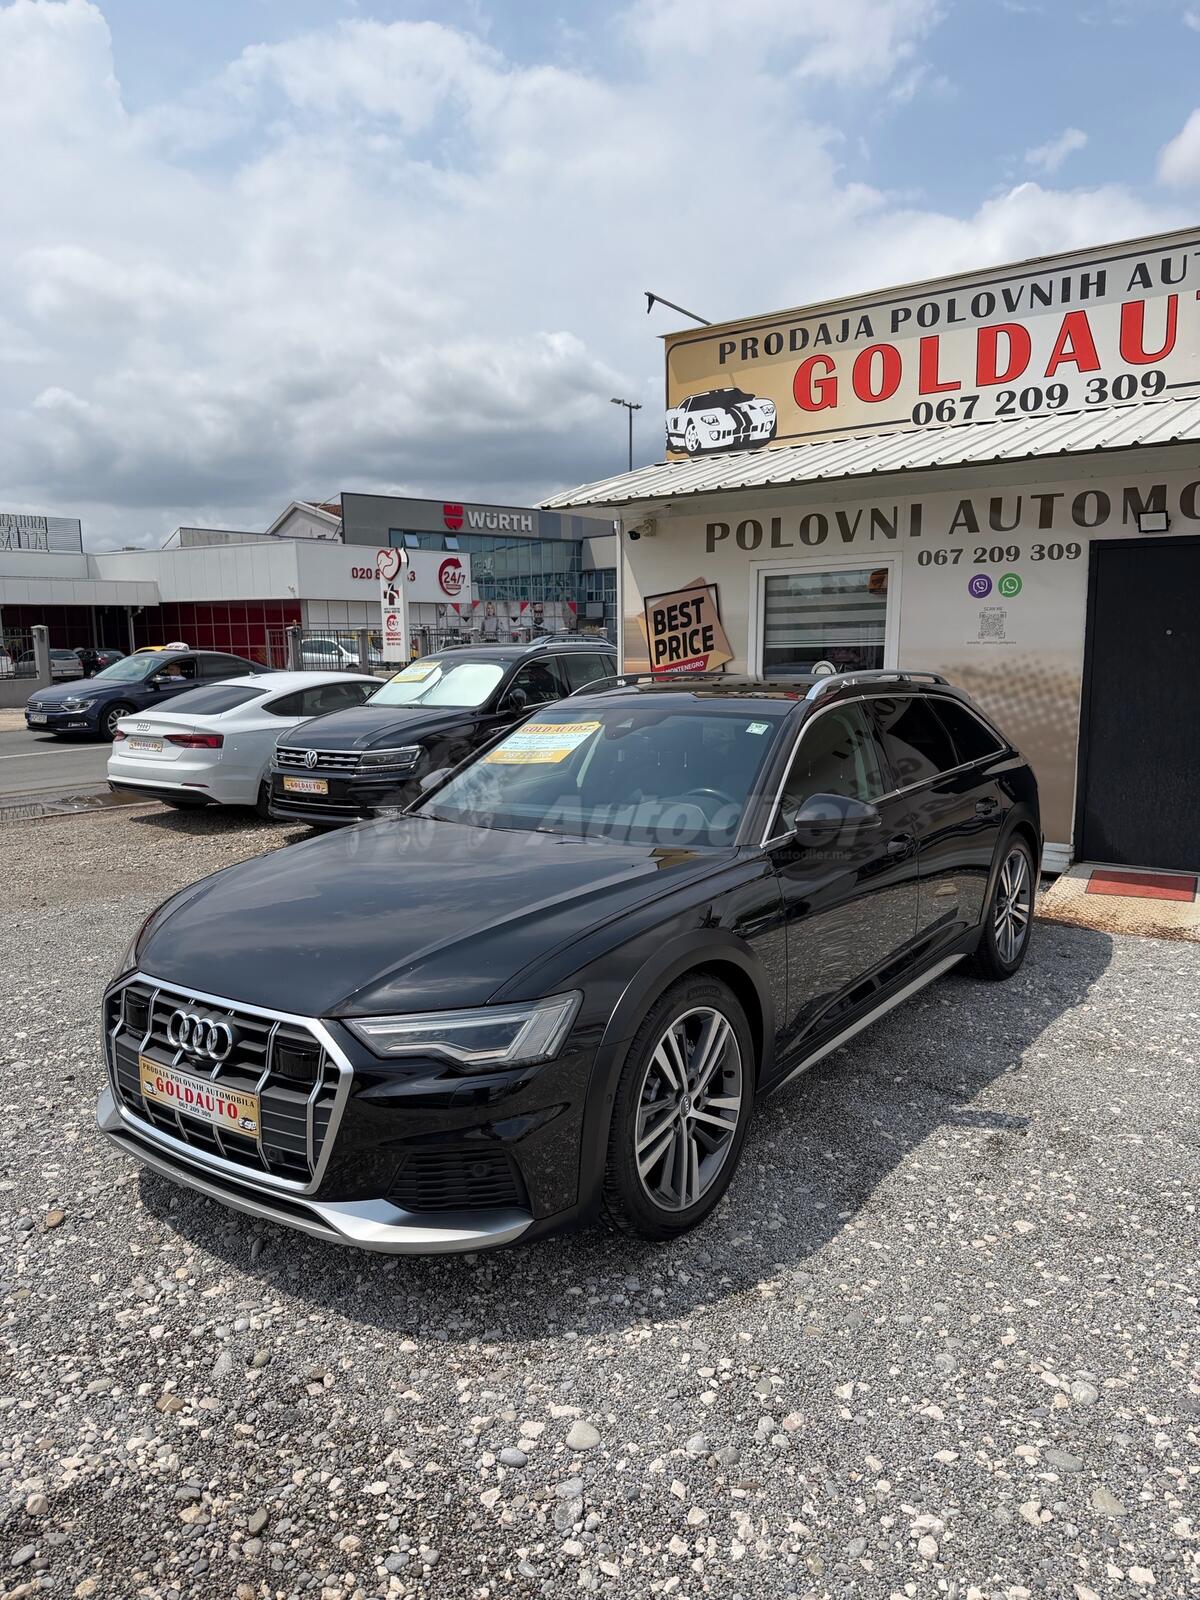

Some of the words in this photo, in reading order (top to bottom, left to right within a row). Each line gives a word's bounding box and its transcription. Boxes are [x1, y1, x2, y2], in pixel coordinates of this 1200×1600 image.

[719, 315, 875, 364] PRODAJA
[890, 270, 1106, 333] POLOVNIH
[1127, 251, 1200, 292] AU
[792, 290, 1200, 412] GOLDAU
[911, 396, 980, 426] 067
[995, 384, 1068, 416] 209
[1085, 370, 1166, 404] 309
[468, 511, 533, 532] WÜRTH
[705, 505, 922, 553] POLOVNI
[351, 567, 372, 579] 020
[917, 549, 964, 566] 067
[973, 545, 1020, 563] 209
[1030, 543, 1082, 561] 309
[443, 571, 466, 584] 24/7
[653, 597, 704, 636] BEST
[655, 625, 714, 665] PRICE
[142, 1063, 170, 1079] PRODAJA
[170, 1075, 204, 1092] POLOVNIH
[205, 1086, 255, 1108] AUTOMOBILA
[156, 1077, 238, 1119] GOLDAUTO
